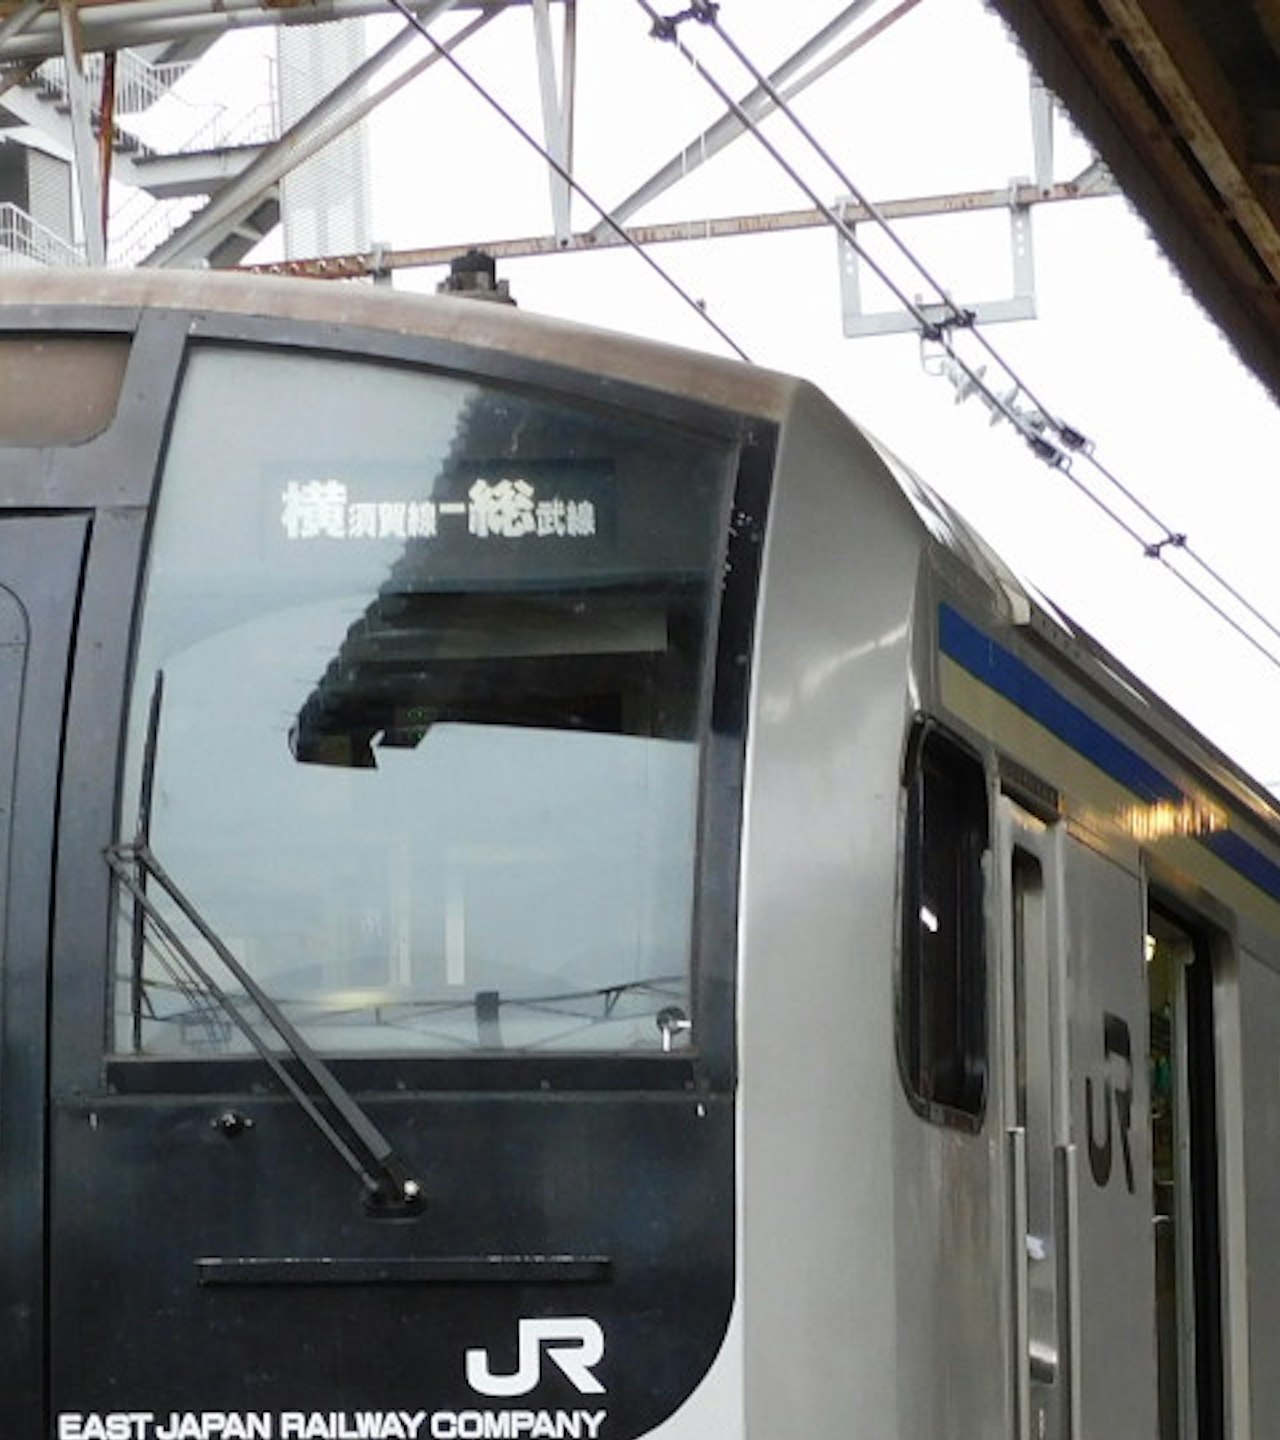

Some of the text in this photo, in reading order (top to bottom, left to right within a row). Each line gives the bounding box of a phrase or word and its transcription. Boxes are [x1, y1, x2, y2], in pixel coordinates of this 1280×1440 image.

[1085, 1011, 1136, 1196] JR
[465, 1316, 606, 1397] JR
[156, 1412, 271, 1440] JAPAN
[280, 1410, 425, 1440] RAILWAY
[430, 1409, 606, 1439] COMPANY
